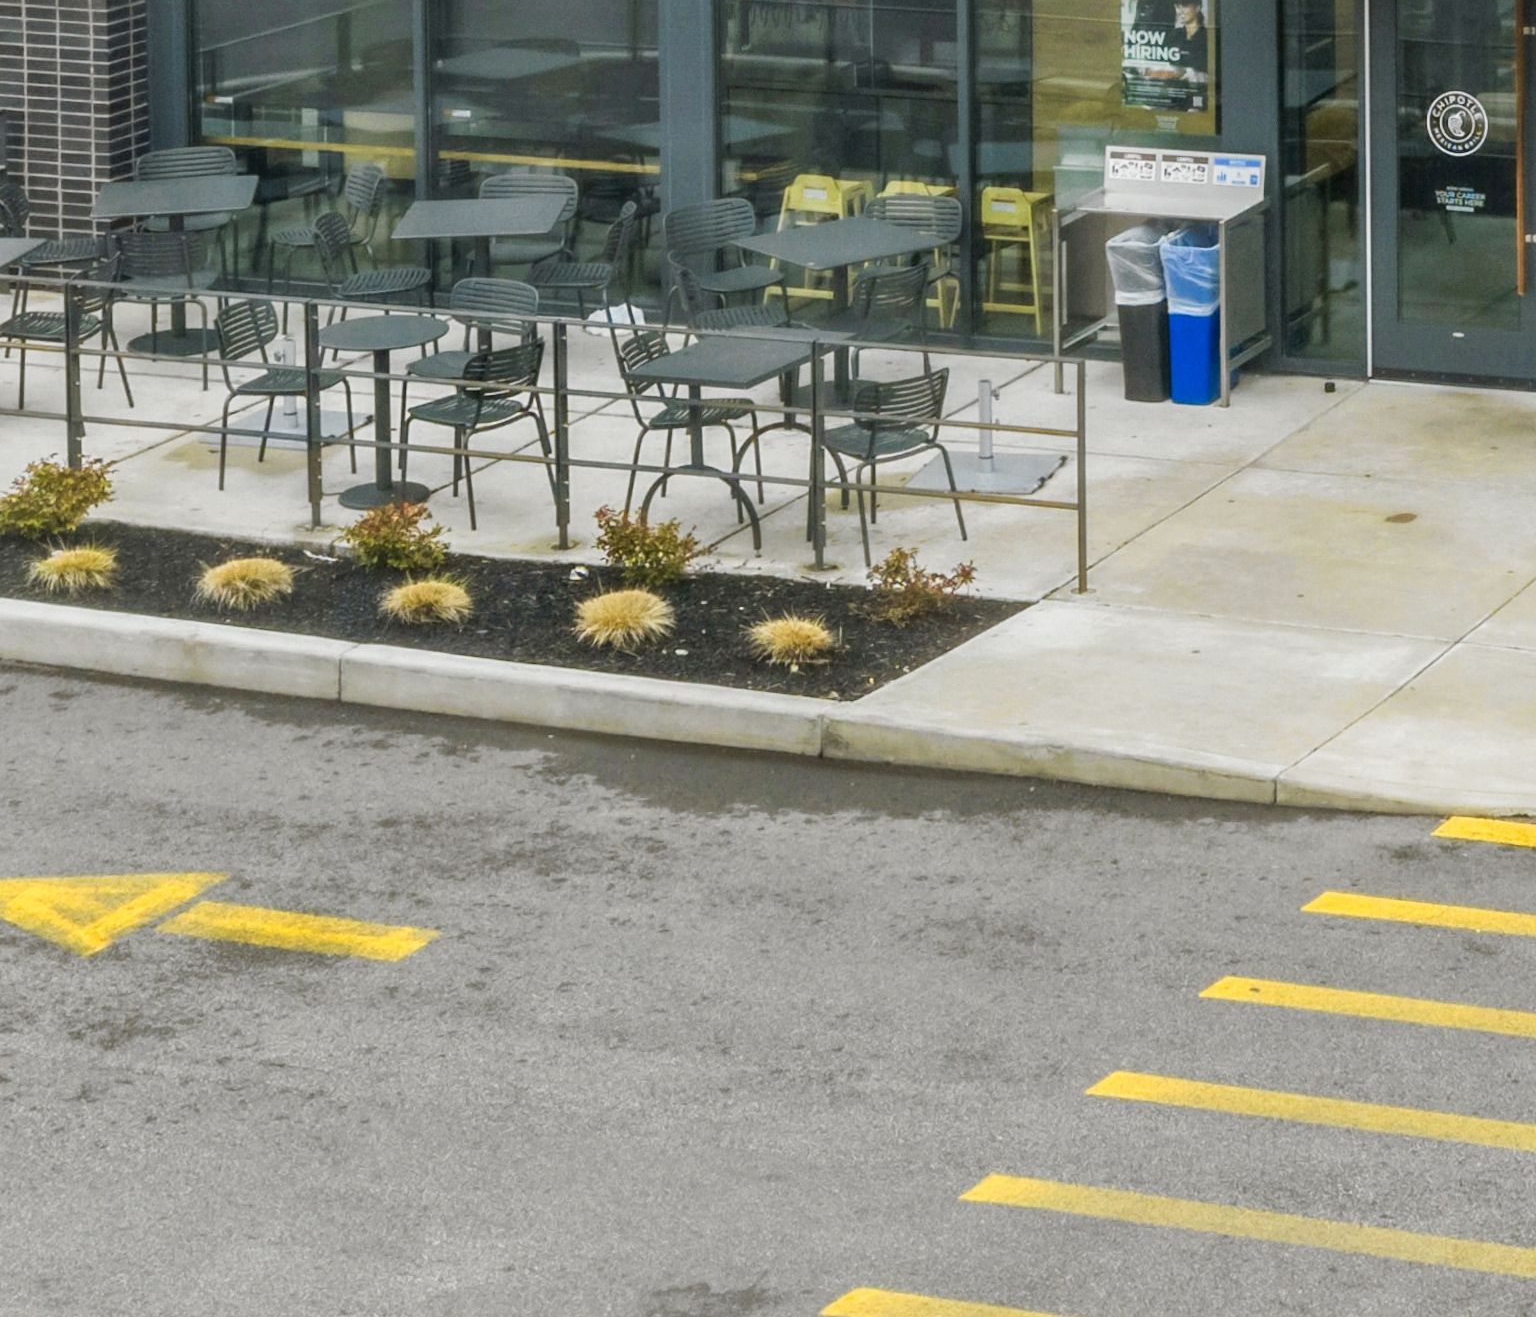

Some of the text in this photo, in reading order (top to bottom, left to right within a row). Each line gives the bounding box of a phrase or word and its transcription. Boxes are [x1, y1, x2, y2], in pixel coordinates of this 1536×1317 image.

[1124, 30, 1166, 45] NOW
[1124, 45, 1181, 61] HIRING
[1432, 96, 1483, 121] CHIPOTLE
